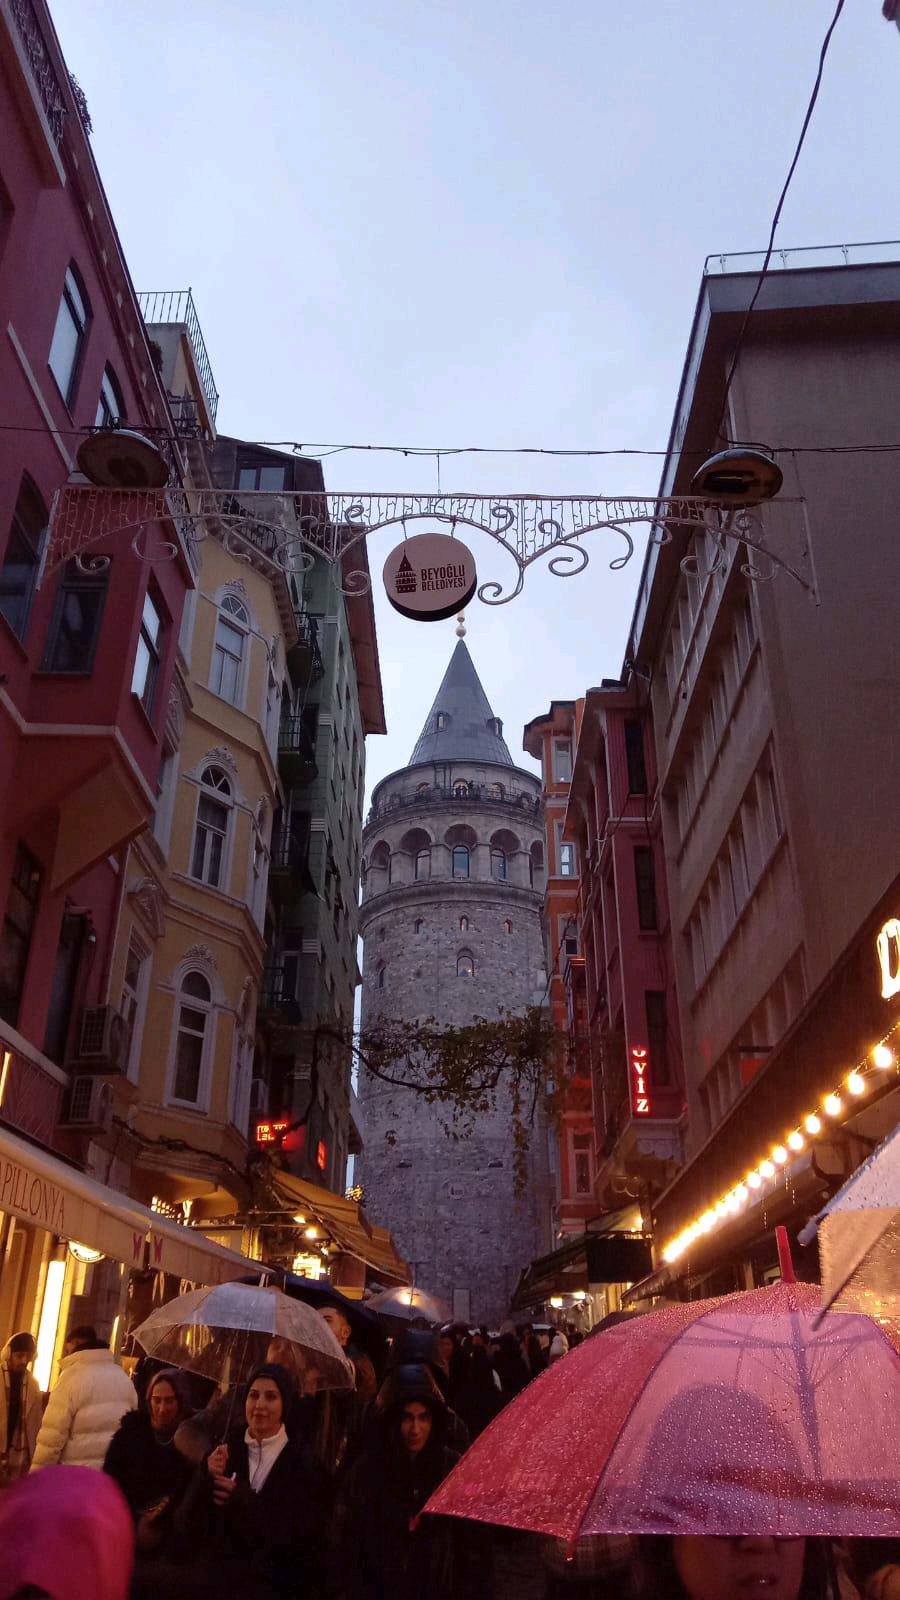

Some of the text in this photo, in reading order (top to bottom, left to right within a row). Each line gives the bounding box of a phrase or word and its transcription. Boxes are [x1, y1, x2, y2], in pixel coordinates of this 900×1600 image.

[421, 564, 465, 580] BEYOĞLU
[421, 577, 466, 591] BELEDİYESİ
[0, 1160, 65, 1230] PILLONYA
